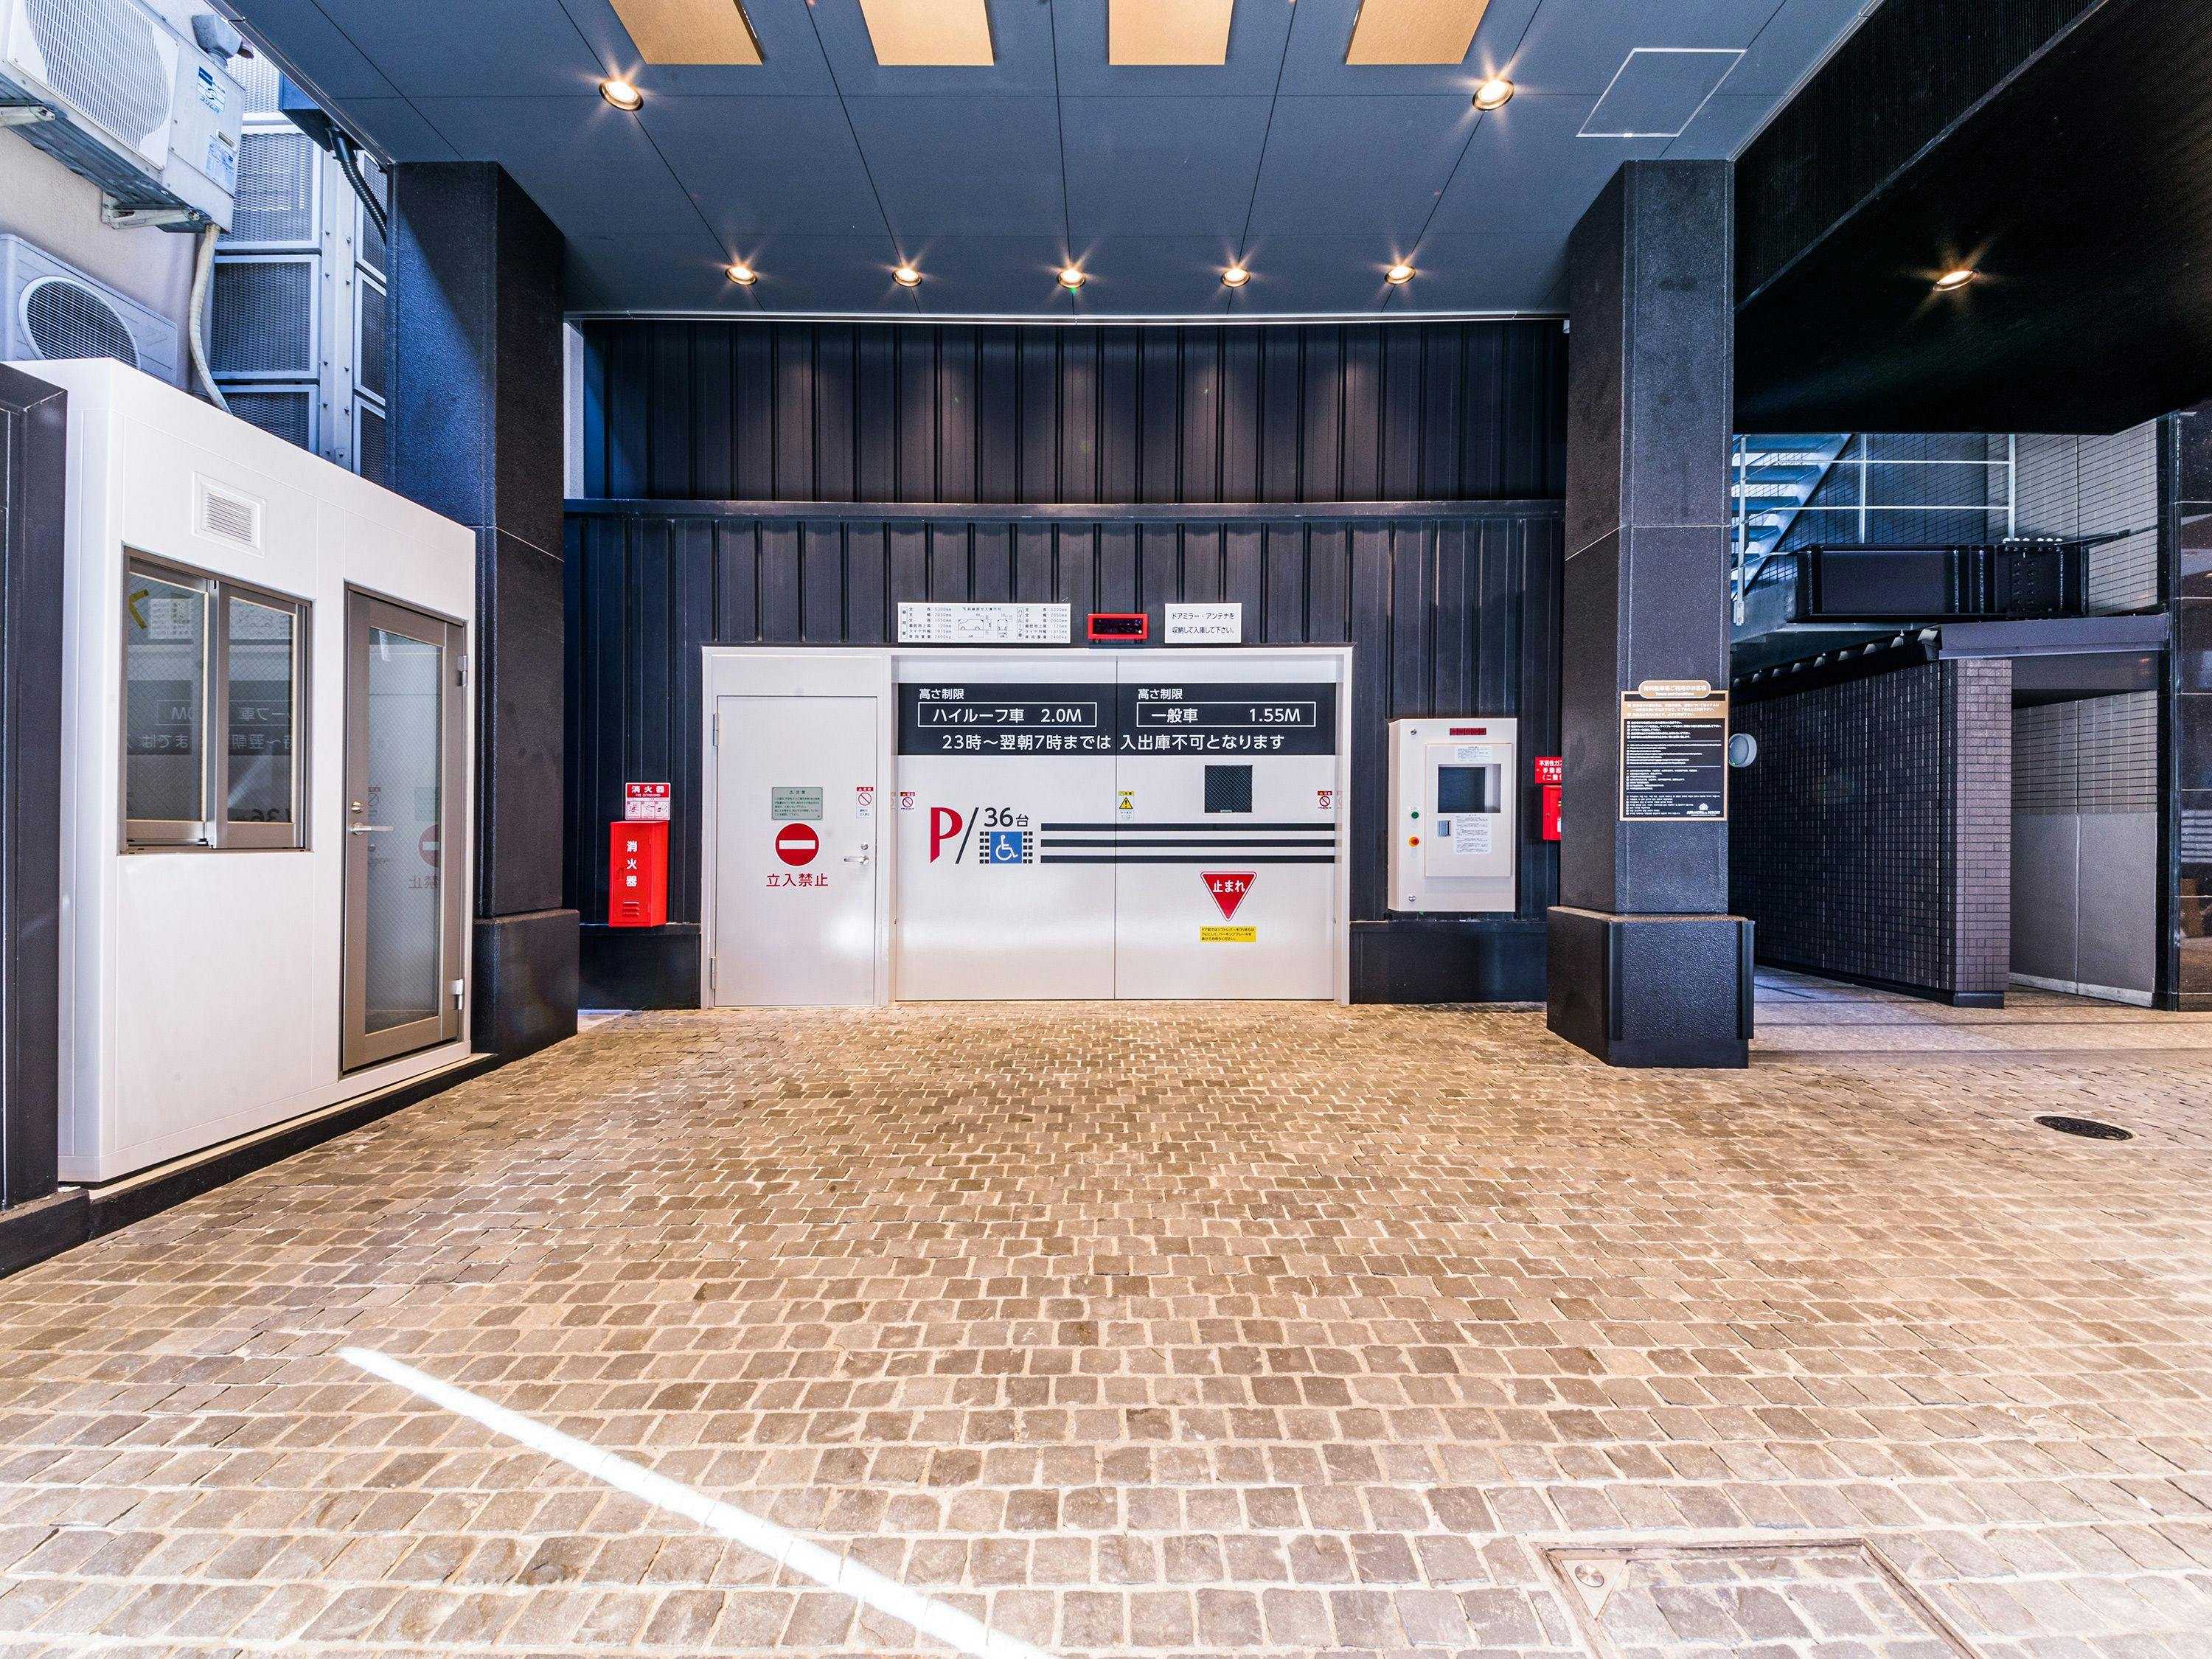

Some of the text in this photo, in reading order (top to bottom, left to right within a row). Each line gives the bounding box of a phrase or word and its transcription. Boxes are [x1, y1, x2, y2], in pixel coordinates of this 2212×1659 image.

[1172, 626, 1235, 634] 収納して入庫して下さい。
[919, 688, 964, 700] 高さ制限
[1138, 688, 1183, 700] 高さ制限
[933, 708, 1082, 723] ハイルーフ車 2.0M
[1151, 708, 1301, 723] 一般車 1.55M
[942, 734, 1284, 751] 23時～翌朝7時までは 入出庫不可となります
[631, 785, 665, 793] 消火器
[626, 841, 638, 887] 消火器
[766, 873, 829, 887] 立入禁止
[1212, 880, 1246, 893] 止まれ
